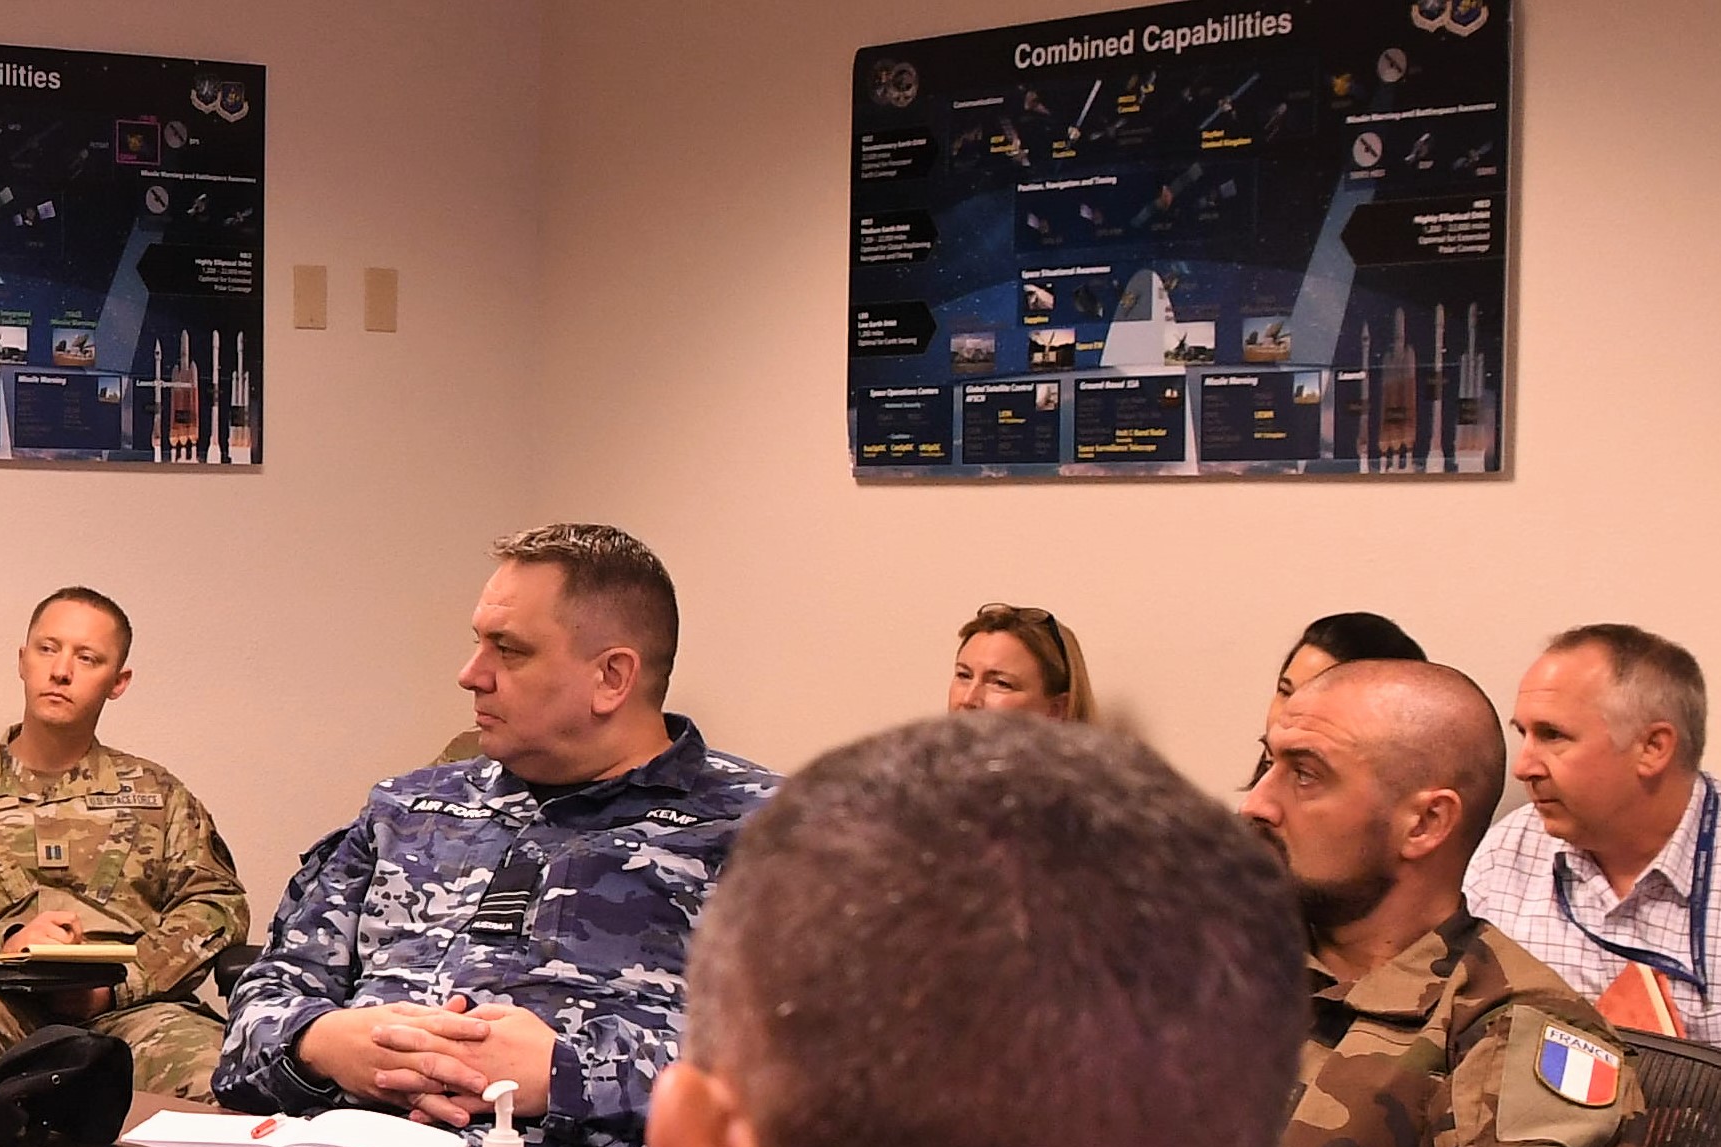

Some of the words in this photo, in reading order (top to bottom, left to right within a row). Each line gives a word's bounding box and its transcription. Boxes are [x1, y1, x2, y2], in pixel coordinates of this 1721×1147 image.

[1015, 30, 1134, 69] Combined
[1143, 12, 1292, 53] Capabilities
[106, 796, 131, 804] SPACE
[133, 795, 157, 804] FORCE
[414, 800, 443, 810] AIR
[443, 804, 493, 818] FORCE
[646, 809, 697, 824] KEMP
[472, 921, 512, 930] AUSTRALIA
[1550, 1030, 1614, 1062] FRANCE
